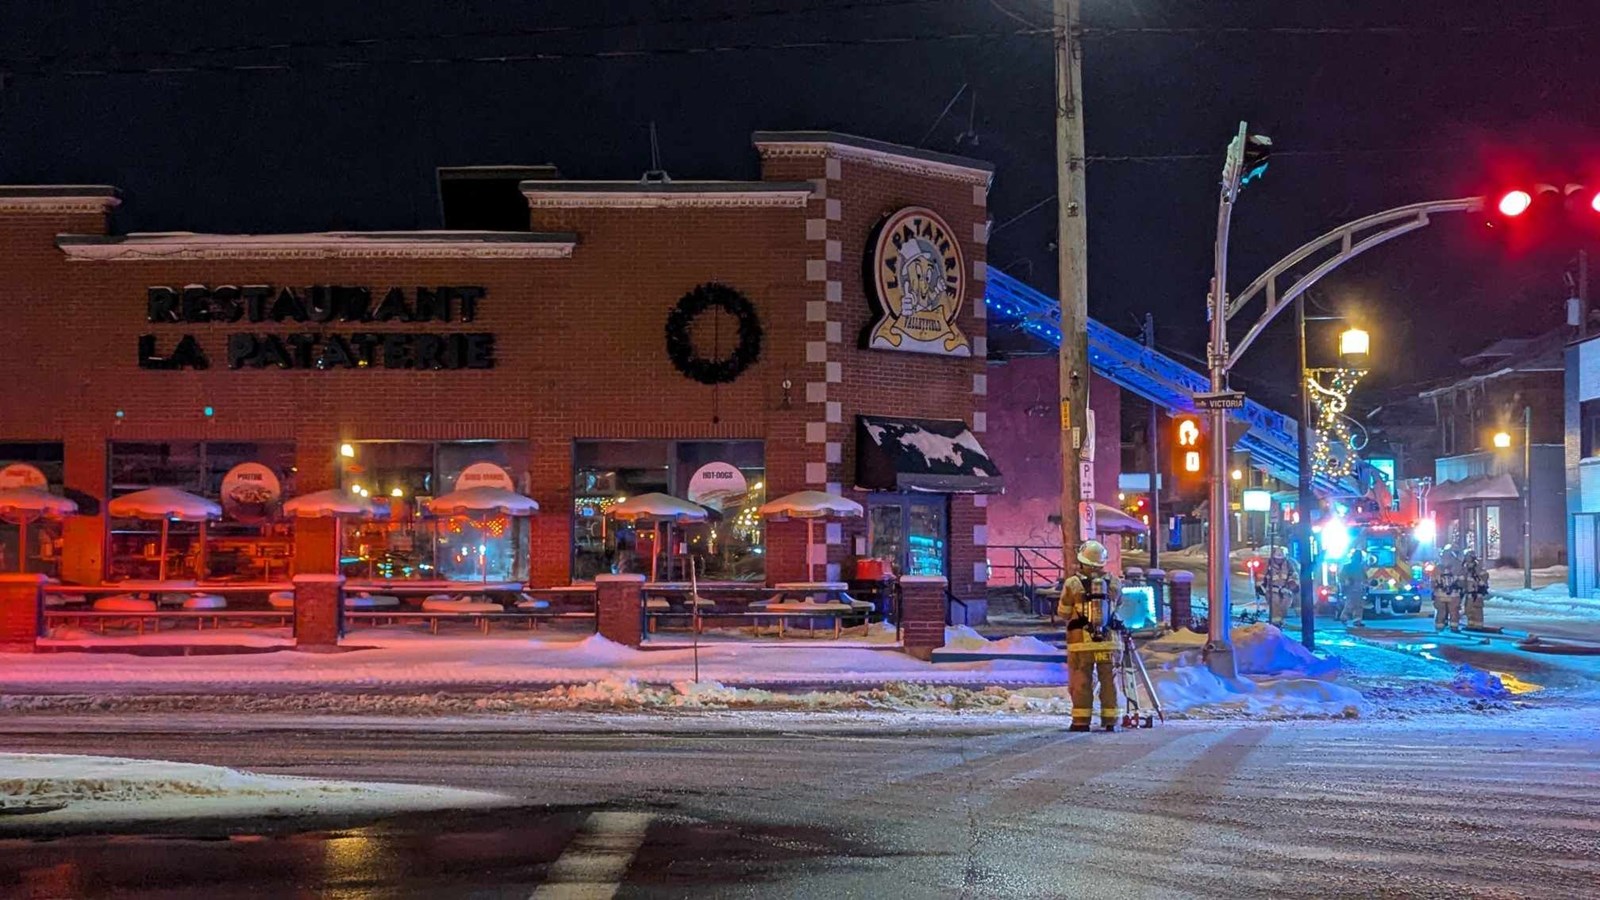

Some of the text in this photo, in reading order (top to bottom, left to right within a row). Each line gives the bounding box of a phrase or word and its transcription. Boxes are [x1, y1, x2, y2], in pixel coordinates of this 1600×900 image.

[886, 257, 898, 289] LA
[147, 284, 487, 322] RESTAURANT
[138, 332, 496, 370] LA PATATERIE
[1209, 400, 1243, 408] VICTORIA
[703, 471, 734, 480] HOT-DOGS
